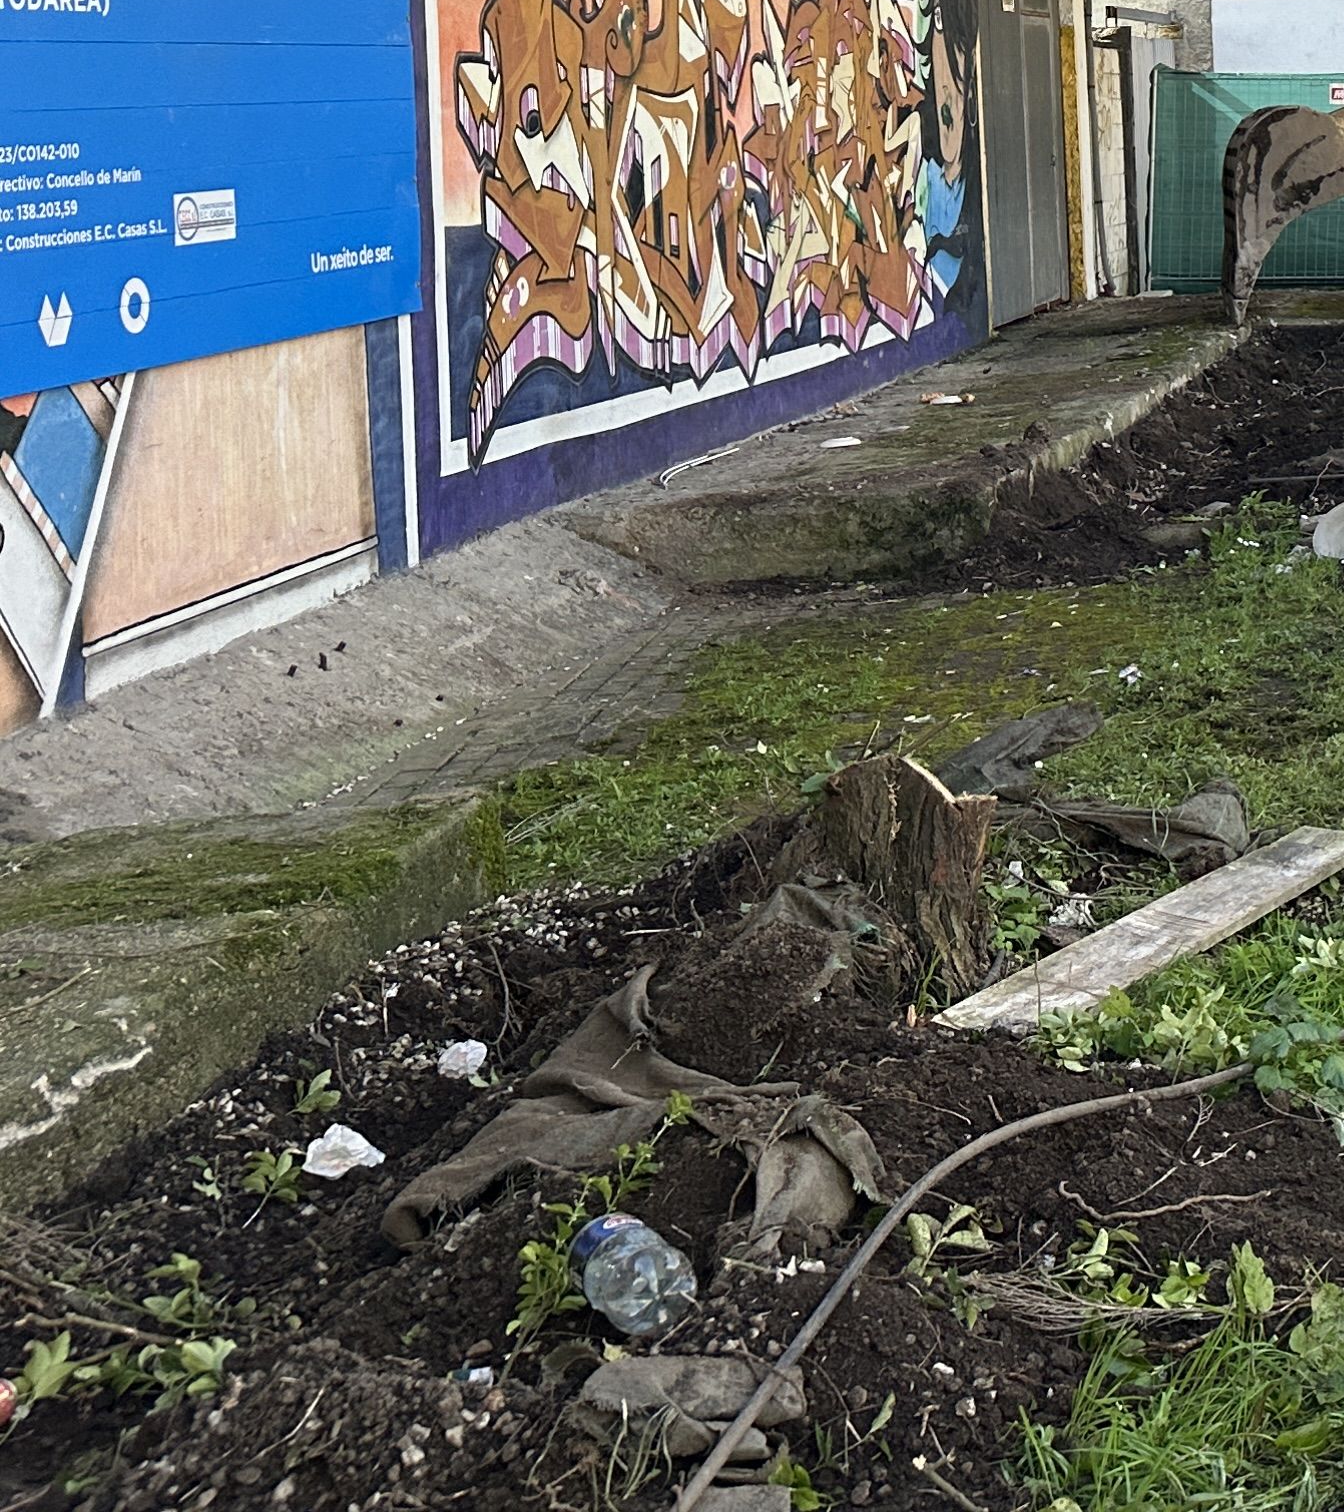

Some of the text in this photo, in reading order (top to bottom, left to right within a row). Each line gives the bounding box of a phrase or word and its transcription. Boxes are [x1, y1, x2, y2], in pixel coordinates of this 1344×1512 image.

[46, 168, 94, 189] Concello
[96, 168, 110, 185] de
[113, 165, 142, 184] Marín
[16, 199, 78, 222] 138.203,59
[6, 227, 92, 252] Construcciones
[94, 224, 115, 242] E.C.
[117, 221, 147, 238] Casas
[311, 244, 394, 273] Un xeito de ser.
